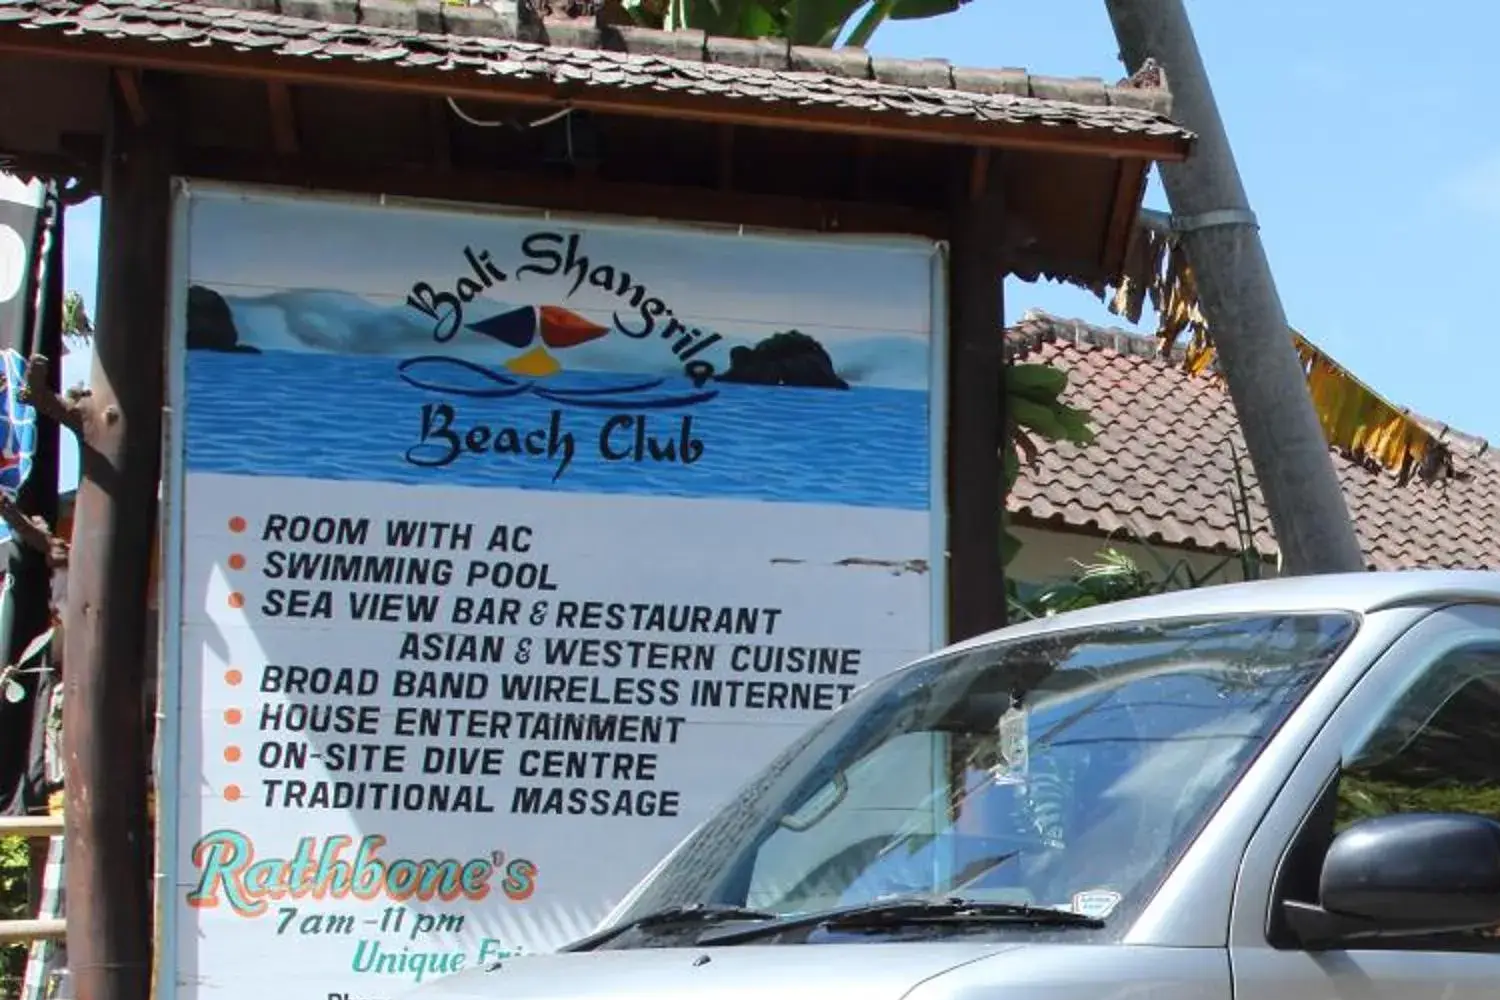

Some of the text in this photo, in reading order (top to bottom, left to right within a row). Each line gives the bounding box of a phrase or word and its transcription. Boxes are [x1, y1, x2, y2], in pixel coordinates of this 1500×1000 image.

[406, 232, 723, 389] Bali Shangrila
[405, 403, 704, 484] Beach Club
[262, 514, 533, 553] ROOM WITH AC
[263, 551, 557, 591] SWIMMING POOL
[262, 589, 782, 635] SEA VIEW BAR & RESTAURANT
[399, 632, 861, 675] ASIAN & WESTERN CUISINE
[260, 665, 856, 710] BROAD BAND WIRELESS INTERNET
[259, 703, 686, 744] HOUSE ENTERTAINMENT
[258, 741, 657, 780] ON-SITE DIVE CENTRE
[262, 779, 680, 816] TRADITIONAL MASSAGE
[186, 829, 538, 917] Rathbone's
[352, 938, 466, 983] Unique
